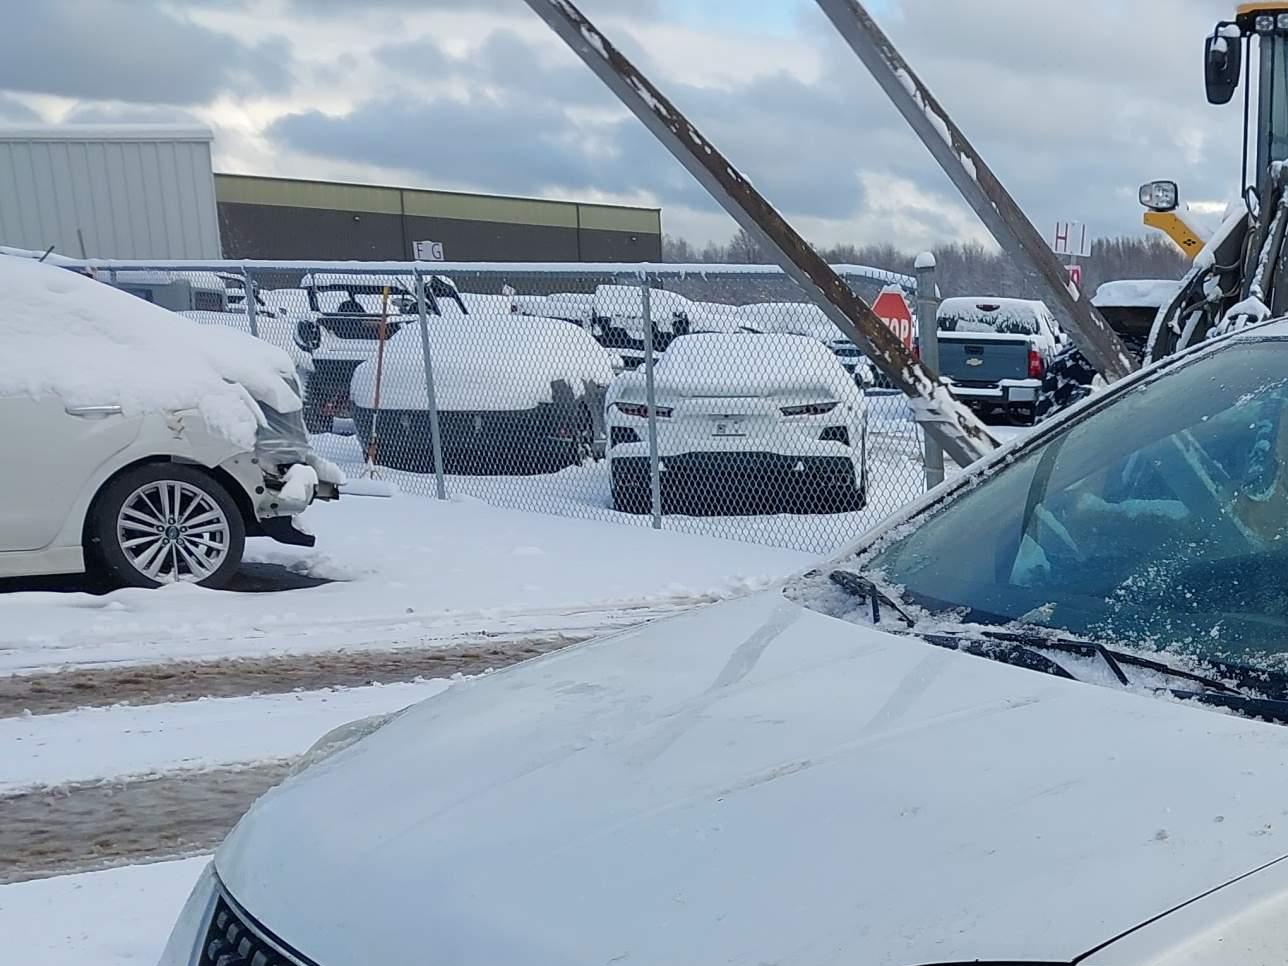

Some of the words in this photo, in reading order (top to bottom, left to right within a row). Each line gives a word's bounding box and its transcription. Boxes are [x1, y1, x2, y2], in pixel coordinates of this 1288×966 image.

[1055, 222, 1068, 252] H
[416, 242, 424, 258] F
[431, 243, 442, 260] G
